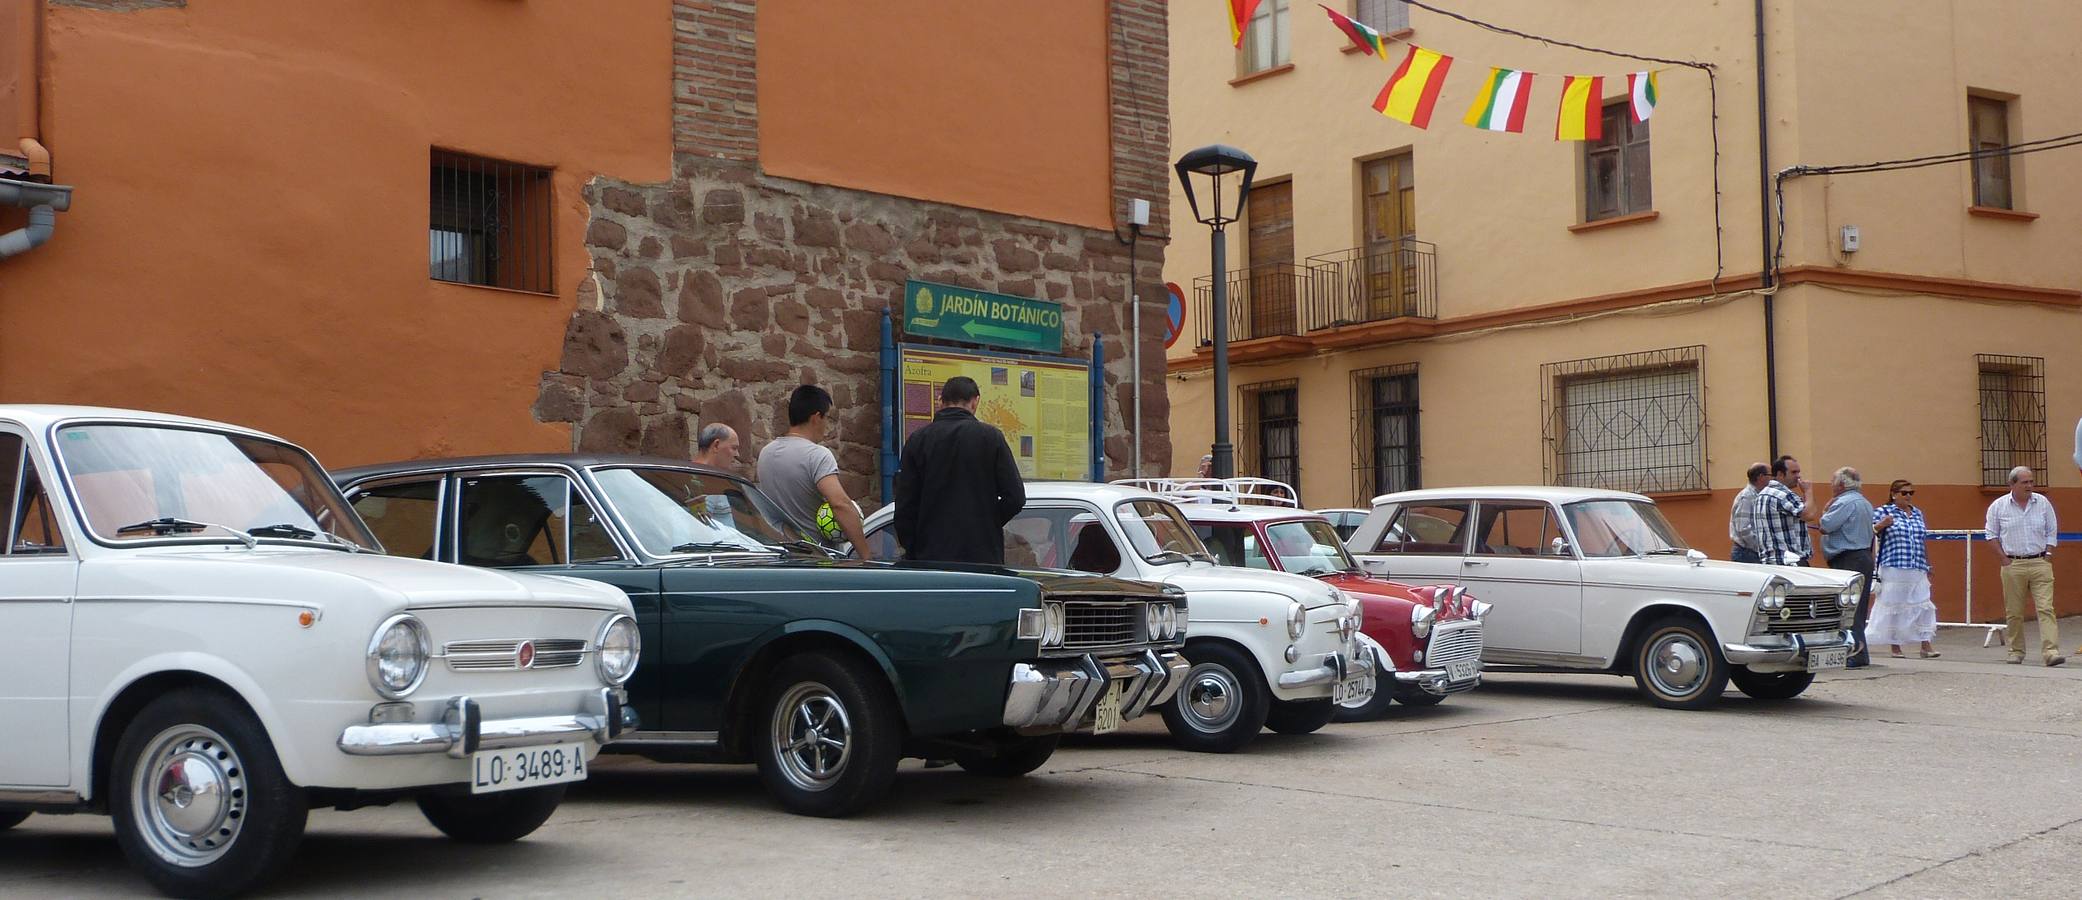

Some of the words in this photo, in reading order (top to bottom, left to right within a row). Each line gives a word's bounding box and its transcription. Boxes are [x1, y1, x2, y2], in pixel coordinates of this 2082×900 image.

[939, 294, 987, 318] JARDÍN
[991, 301, 1059, 328] BOTÁNICO
[904, 366, 932, 377] Azofra
[1097, 706, 1117, 731] 5201
